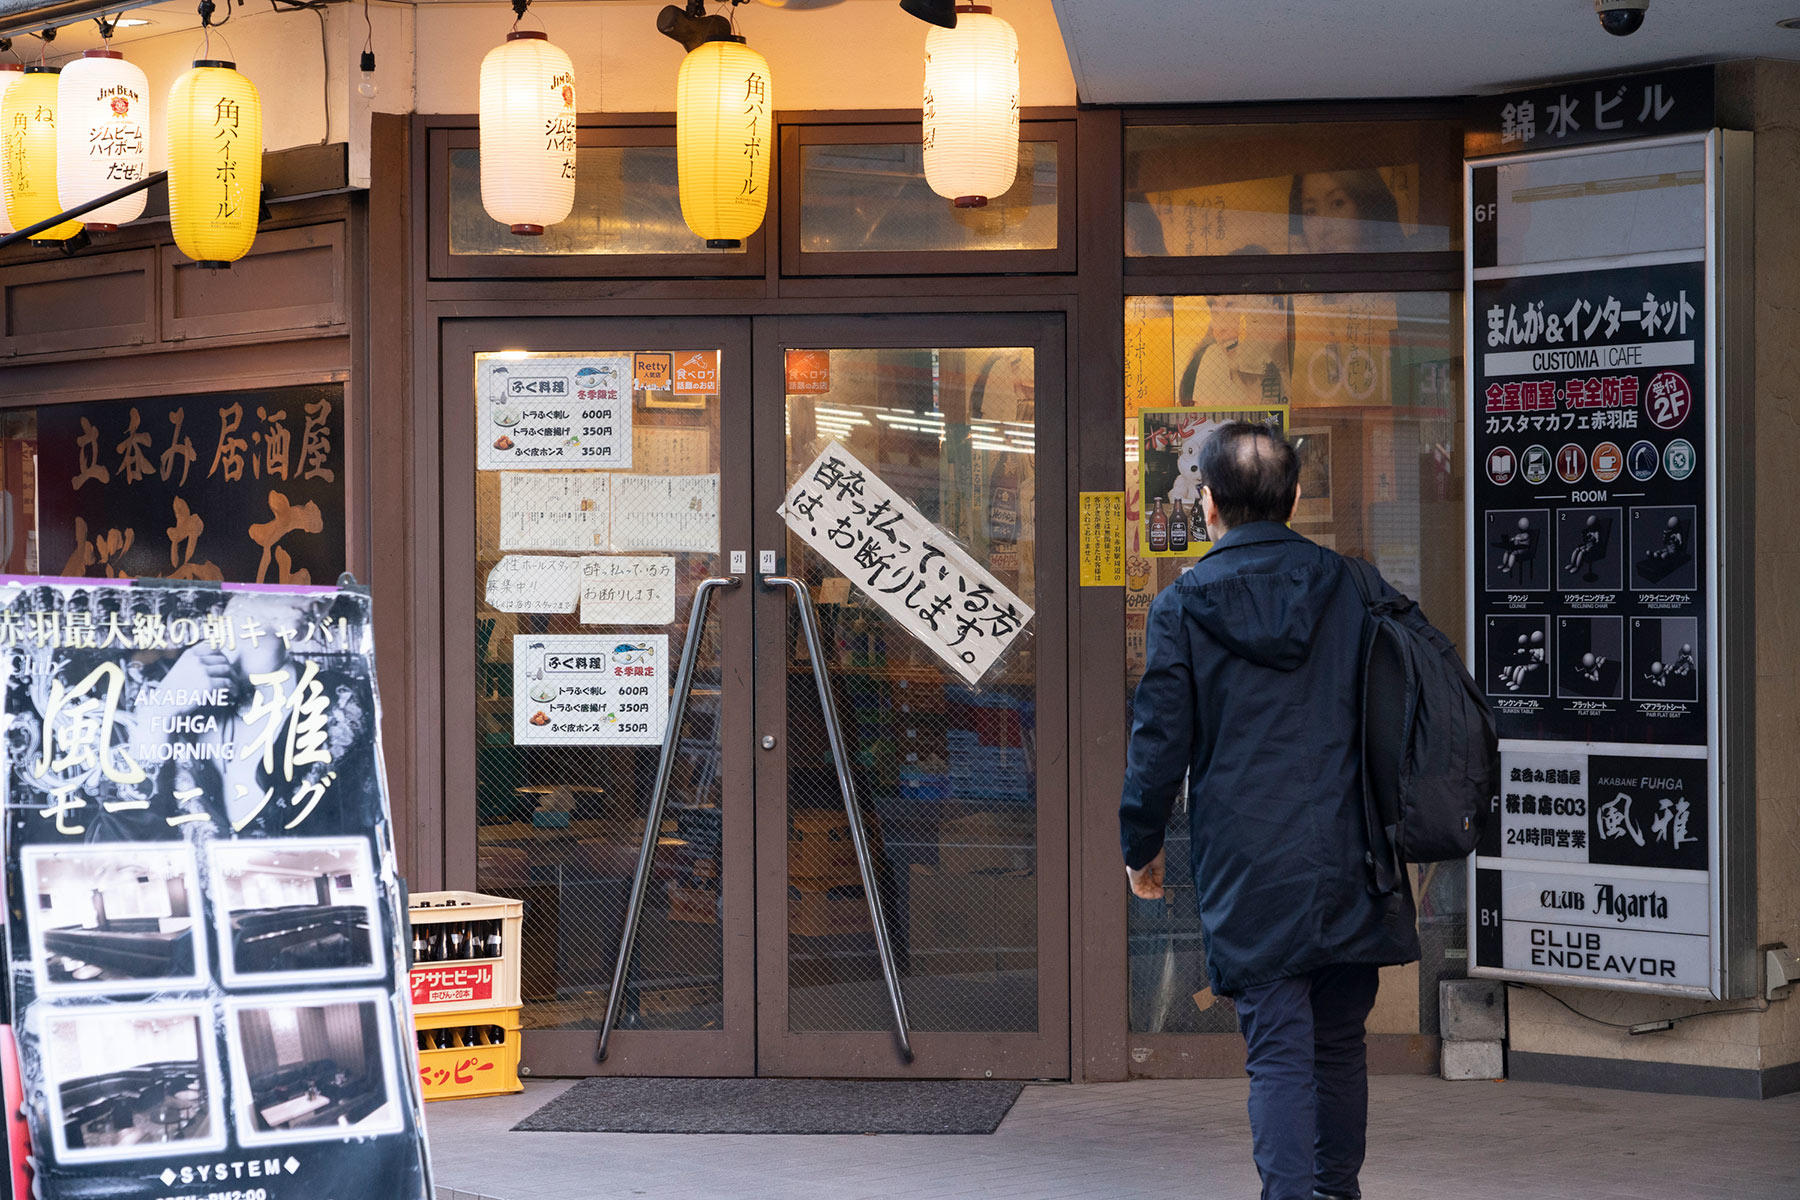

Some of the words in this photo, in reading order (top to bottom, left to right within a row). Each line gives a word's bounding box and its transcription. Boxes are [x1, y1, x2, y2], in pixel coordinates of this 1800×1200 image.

[97, 87, 115, 101] JIM
[1500, 84, 1676, 145] 錦水ビル
[89, 125, 143, 142] ジムビーム
[744, 72, 766, 197] 角ハイボール
[89, 139, 144, 157] ハイボール
[215, 97, 240, 220] 角ハイボール
[1474, 203, 1497, 223] 6F
[1487, 290, 1696, 347] まんが&インターネット
[638, 361, 668, 372] Retty
[1532, 352, 1600, 372] CUSTOMA
[1608, 346, 1642, 366] CAFE
[676, 368, 715, 379] 食べログ
[788, 368, 827, 379] 食べログ
[511, 380, 565, 394] ふぐ料理
[577, 389, 618, 400] 冬季限定
[676, 382, 715, 390] 話題のお店
[1485, 375, 1640, 413] 全室個室・完全防音
[1652, 377, 1678, 398] 受付
[522, 410, 570, 420] トラふぐ刺し
[582, 409, 612, 419] 600円
[1654, 389, 1686, 424] 2F
[1486, 409, 1639, 434] カスタマカフェ赤羽店
[582, 426, 613, 436] 350円
[581, 446, 612, 456] 350円
[1571, 491, 1607, 502] ROOM
[812, 456, 1021, 637] 酔っ払っている方
[583, 563, 670, 577] 酔っ払っている方
[793, 489, 983, 664] は、お断りします。
[584, 587, 661, 601] お断りします。
[1507, 594, 1529, 602] ラウンジ
[0, 610, 348, 650] 赤羽最大級の朝キャバ!
[1635, 620, 1641, 628] 6
[548, 656, 601, 669] ふぐ料理
[614, 666, 655, 677] 冬季限定
[134, 688, 230, 707] AKABANE
[559, 686, 607, 696] トラふぐ刺し
[618, 686, 649, 696] 600円
[619, 703, 649, 712] 350円
[34, 660, 147, 784] 風
[241, 660, 334, 782] 雅
[149, 715, 218, 734] FUHGA
[618, 723, 648, 733] 350円
[138, 743, 234, 761] MORNING
[1598, 777, 1638, 787] AKABANE
[1640, 776, 1684, 791] FUHGA
[39, 771, 337, 835] モーニング
[1597, 792, 1699, 850] 風雅
[1507, 827, 1586, 849] 24時間営業
[1540, 889, 1585, 911] CLUB
[1592, 883, 1668, 923] Agarta
[1480, 909, 1499, 927] B1
[1531, 928, 1601, 950] CLUB
[1531, 948, 1677, 978] ENDEAVOR
[410, 967, 491, 989] アサヒビール
[180, 1158, 281, 1184] SYSTEM
